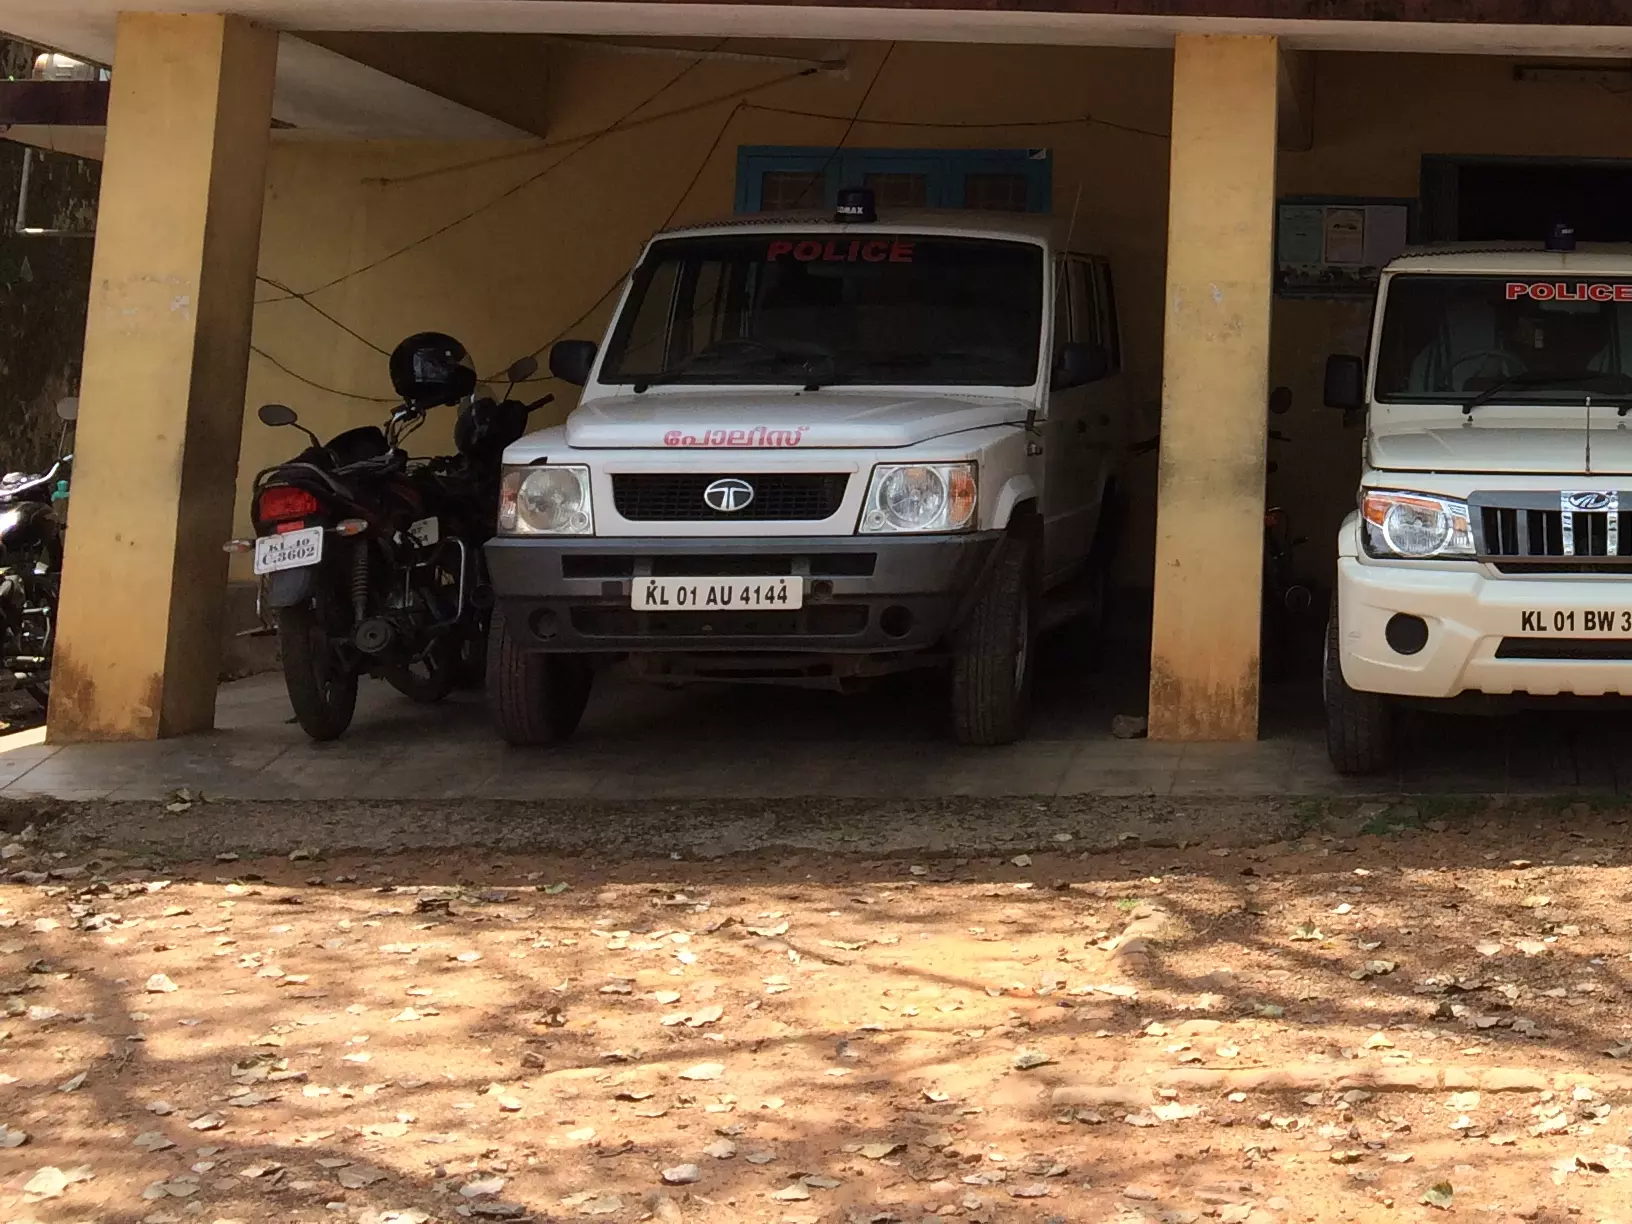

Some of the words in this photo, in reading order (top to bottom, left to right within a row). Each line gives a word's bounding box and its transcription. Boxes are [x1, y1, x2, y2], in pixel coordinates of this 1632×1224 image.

[766, 240, 914, 263] POLICE
[262, 546, 315, 566] C.3602
[646, 582, 669, 605] KL
[676, 585, 699, 605] 01
[705, 584, 733, 605] AU
[739, 584, 789, 605] 4144
[1522, 610, 1548, 632] KL
[1554, 611, 1576, 632] 01
[1584, 611, 1616, 632] BW
